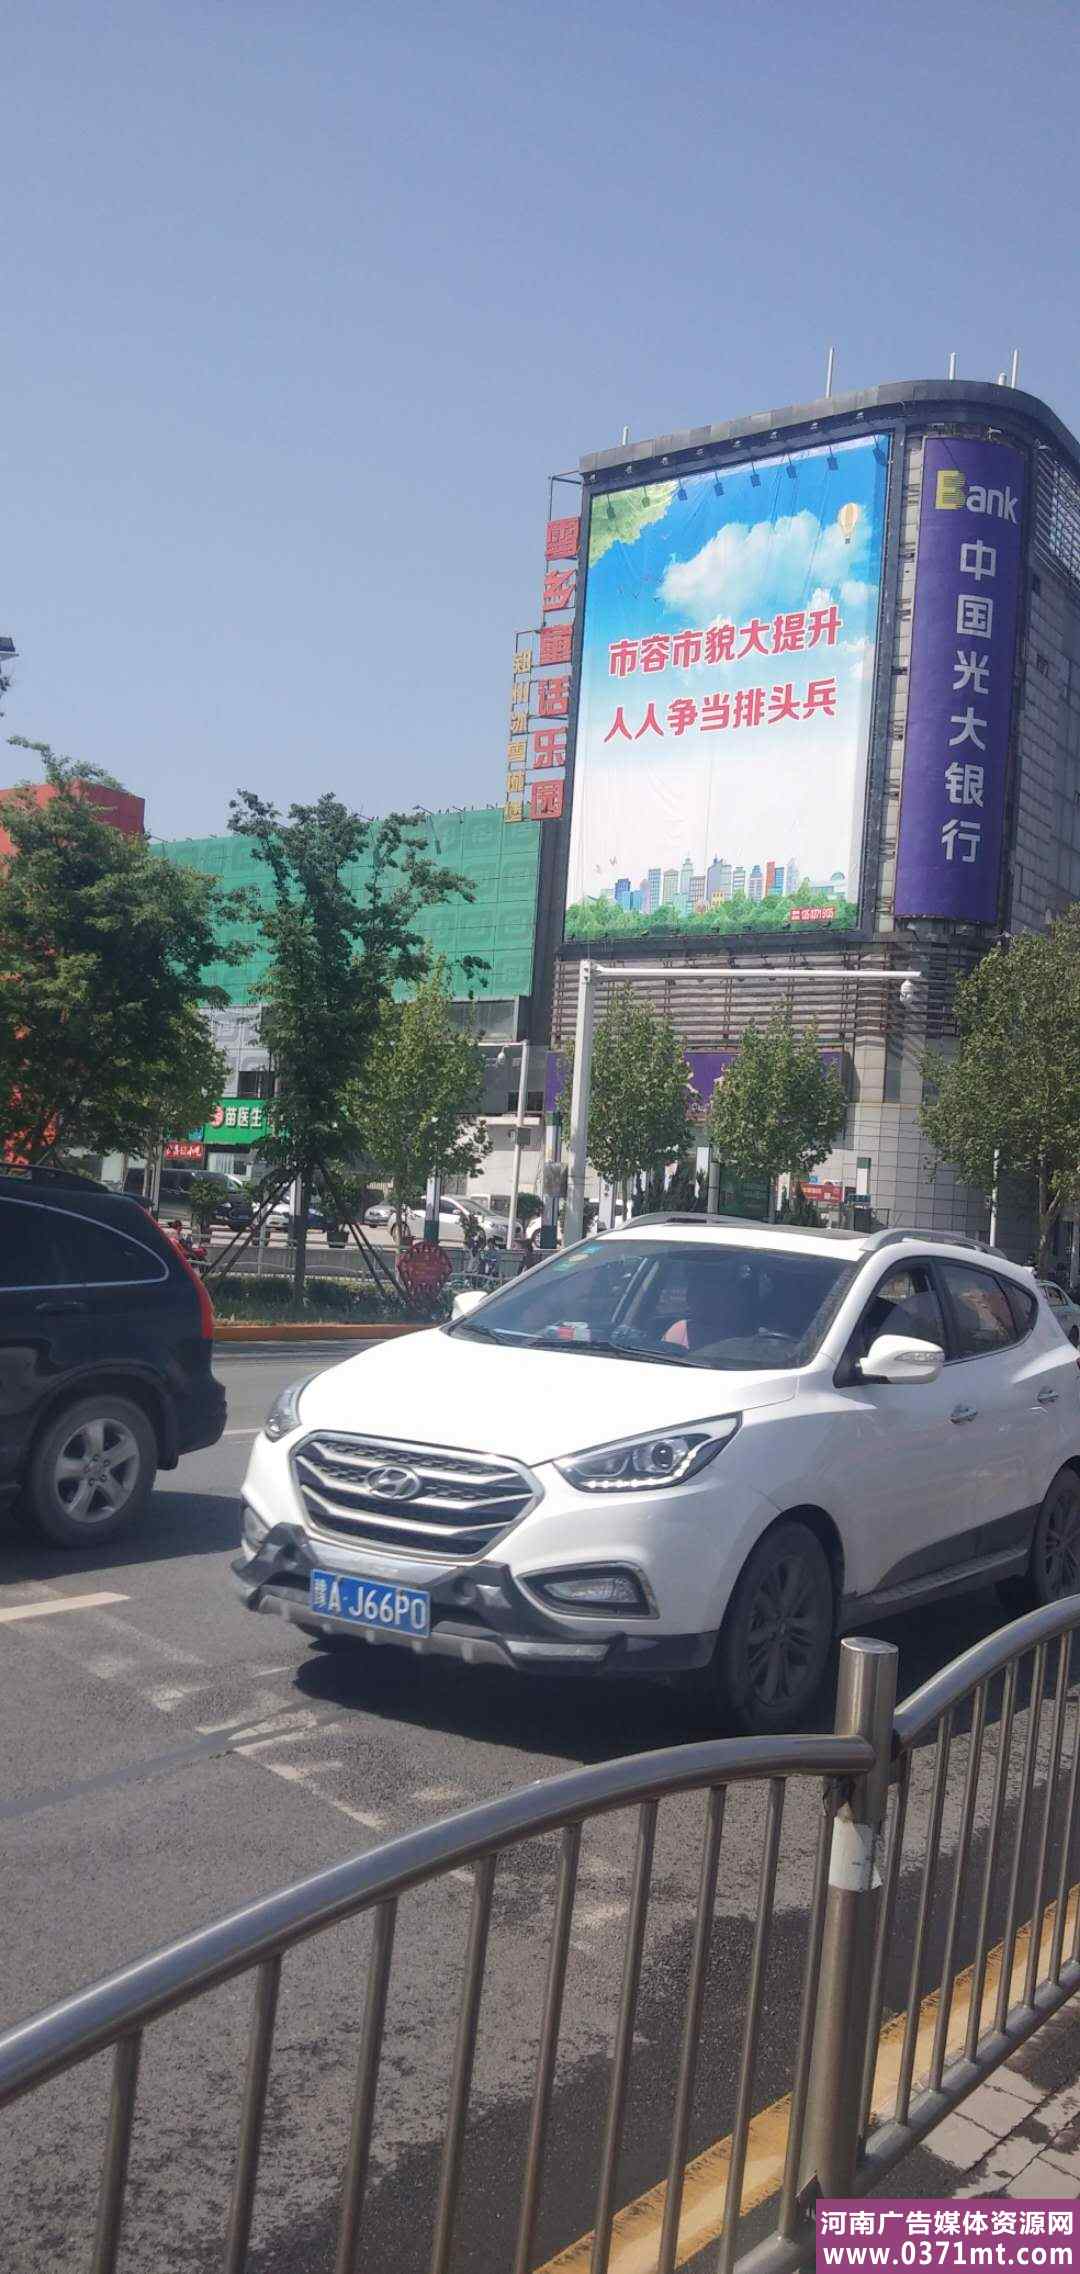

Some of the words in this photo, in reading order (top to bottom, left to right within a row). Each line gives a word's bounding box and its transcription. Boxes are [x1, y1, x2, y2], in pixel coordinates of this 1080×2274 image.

[935, 470, 1019, 523] Bank
[608, 606, 842, 678] 市容市貌大提升
[603, 678, 837, 743] 人人争当排头兵
[941, 540, 997, 863] 中国光大银行
[225, 1105, 262, 1127] 苗医生
